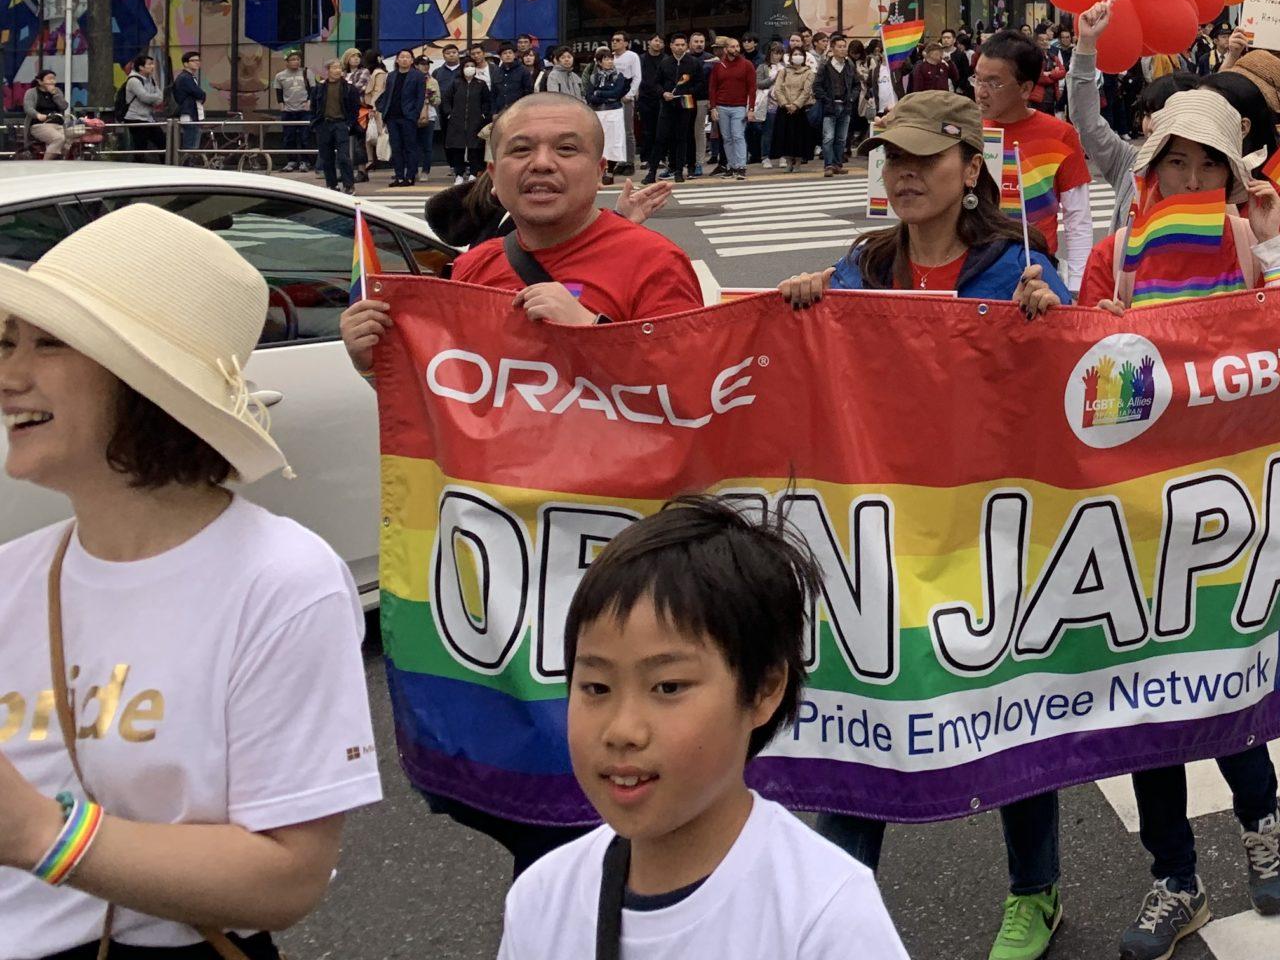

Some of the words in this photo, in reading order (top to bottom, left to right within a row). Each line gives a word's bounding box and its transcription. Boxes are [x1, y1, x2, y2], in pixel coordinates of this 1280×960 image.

[426, 348, 758, 429] ORACLE
[1085, 399, 1116, 411] LGBT
[1127, 396, 1152, 408] Allies
[428, 485, 900, 685] OPN
[907, 673, 1094, 756] Employee
[1108, 651, 1270, 712] Network
